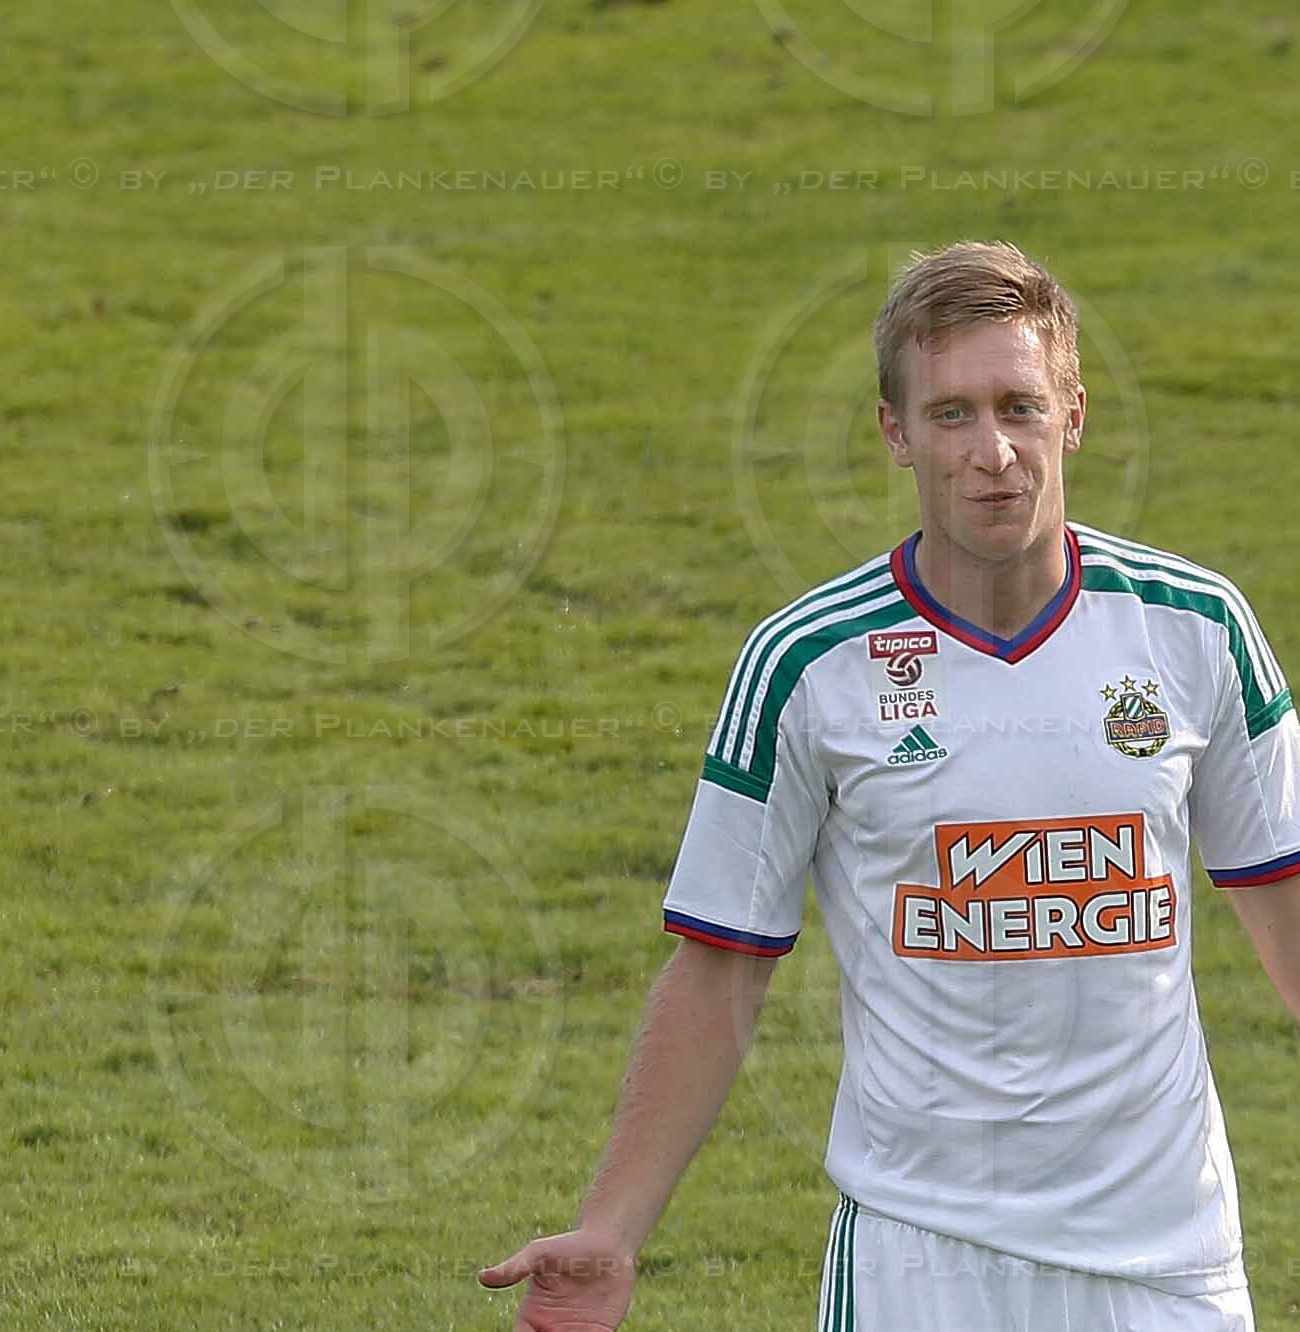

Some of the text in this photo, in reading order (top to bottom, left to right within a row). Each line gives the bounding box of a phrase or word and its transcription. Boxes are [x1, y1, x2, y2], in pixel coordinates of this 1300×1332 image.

[880, 690, 934, 704] BUNDES
[880, 701, 937, 721] LIGA
[1110, 719, 1165, 738] RAPID
[887, 748, 948, 765] adidas
[949, 825, 1134, 889] WIEN
[902, 886, 1173, 952] ENERGIE
